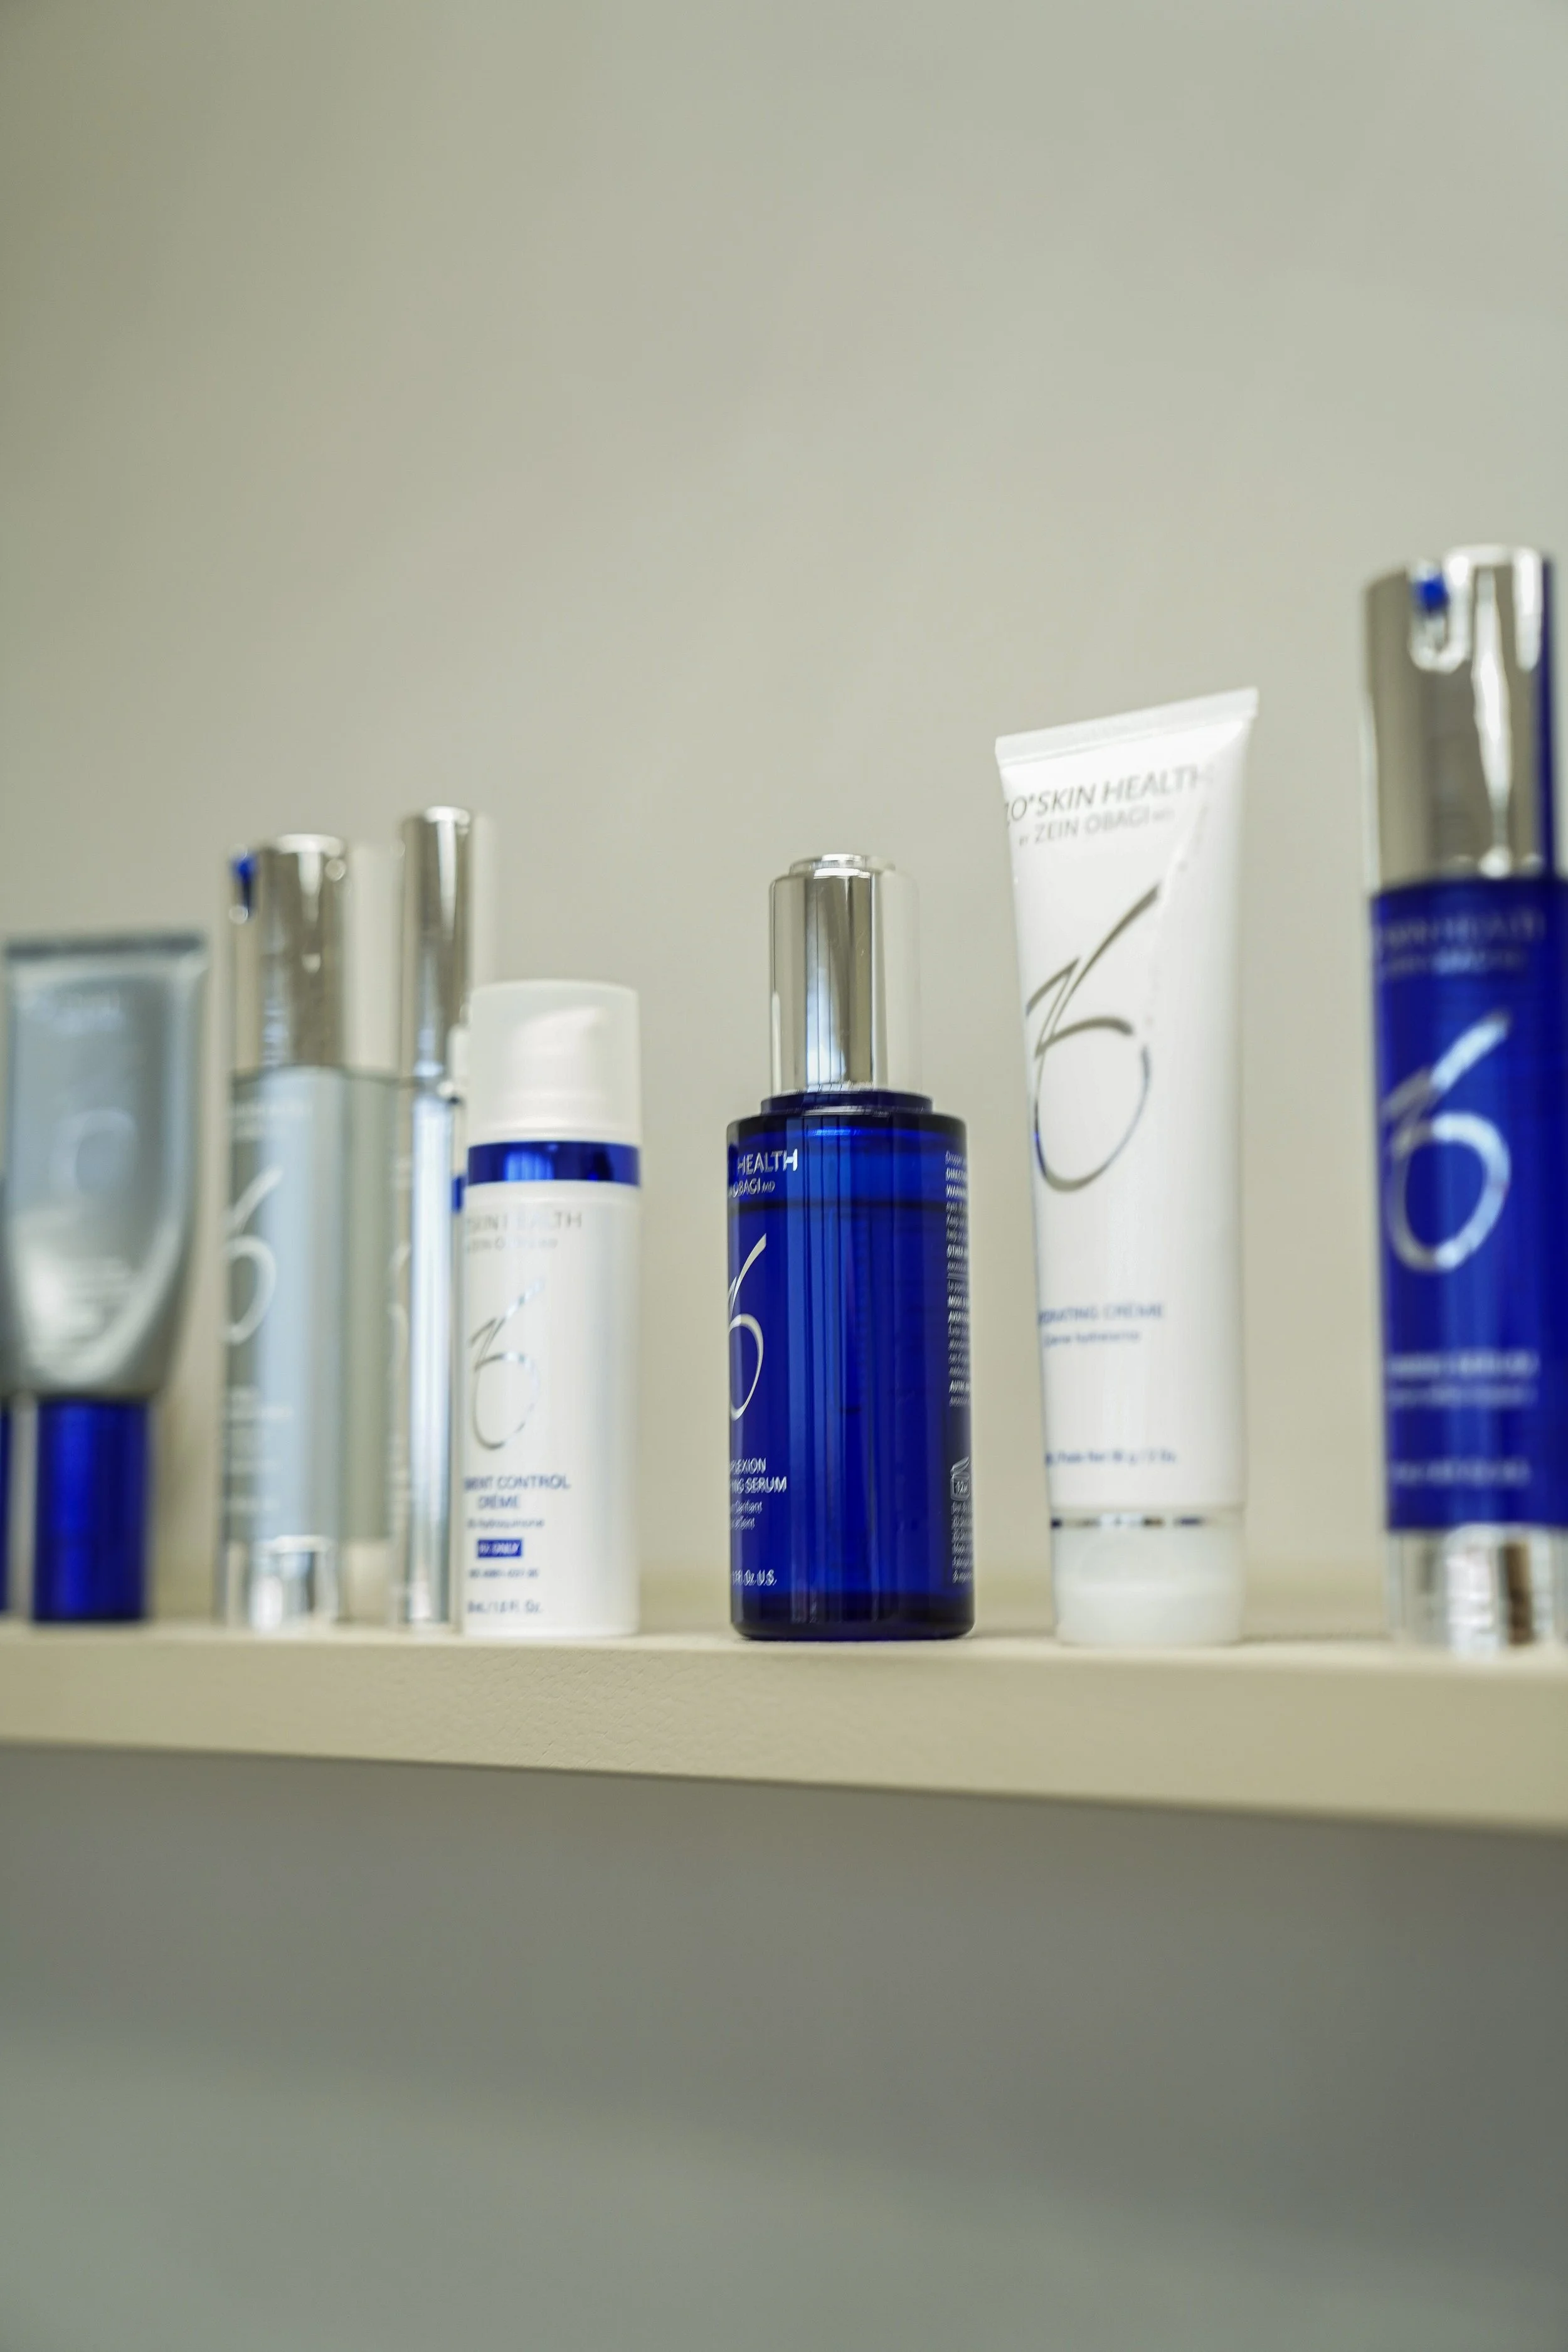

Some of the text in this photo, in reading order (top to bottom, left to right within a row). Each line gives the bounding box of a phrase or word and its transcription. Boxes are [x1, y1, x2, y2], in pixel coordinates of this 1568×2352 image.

[737, 1147, 798, 1176] HEALTH
[733, 1177, 760, 1199] OBAGI
[496, 1473, 571, 1490] CONTROL
[745, 1476, 788, 1493] SERUM
